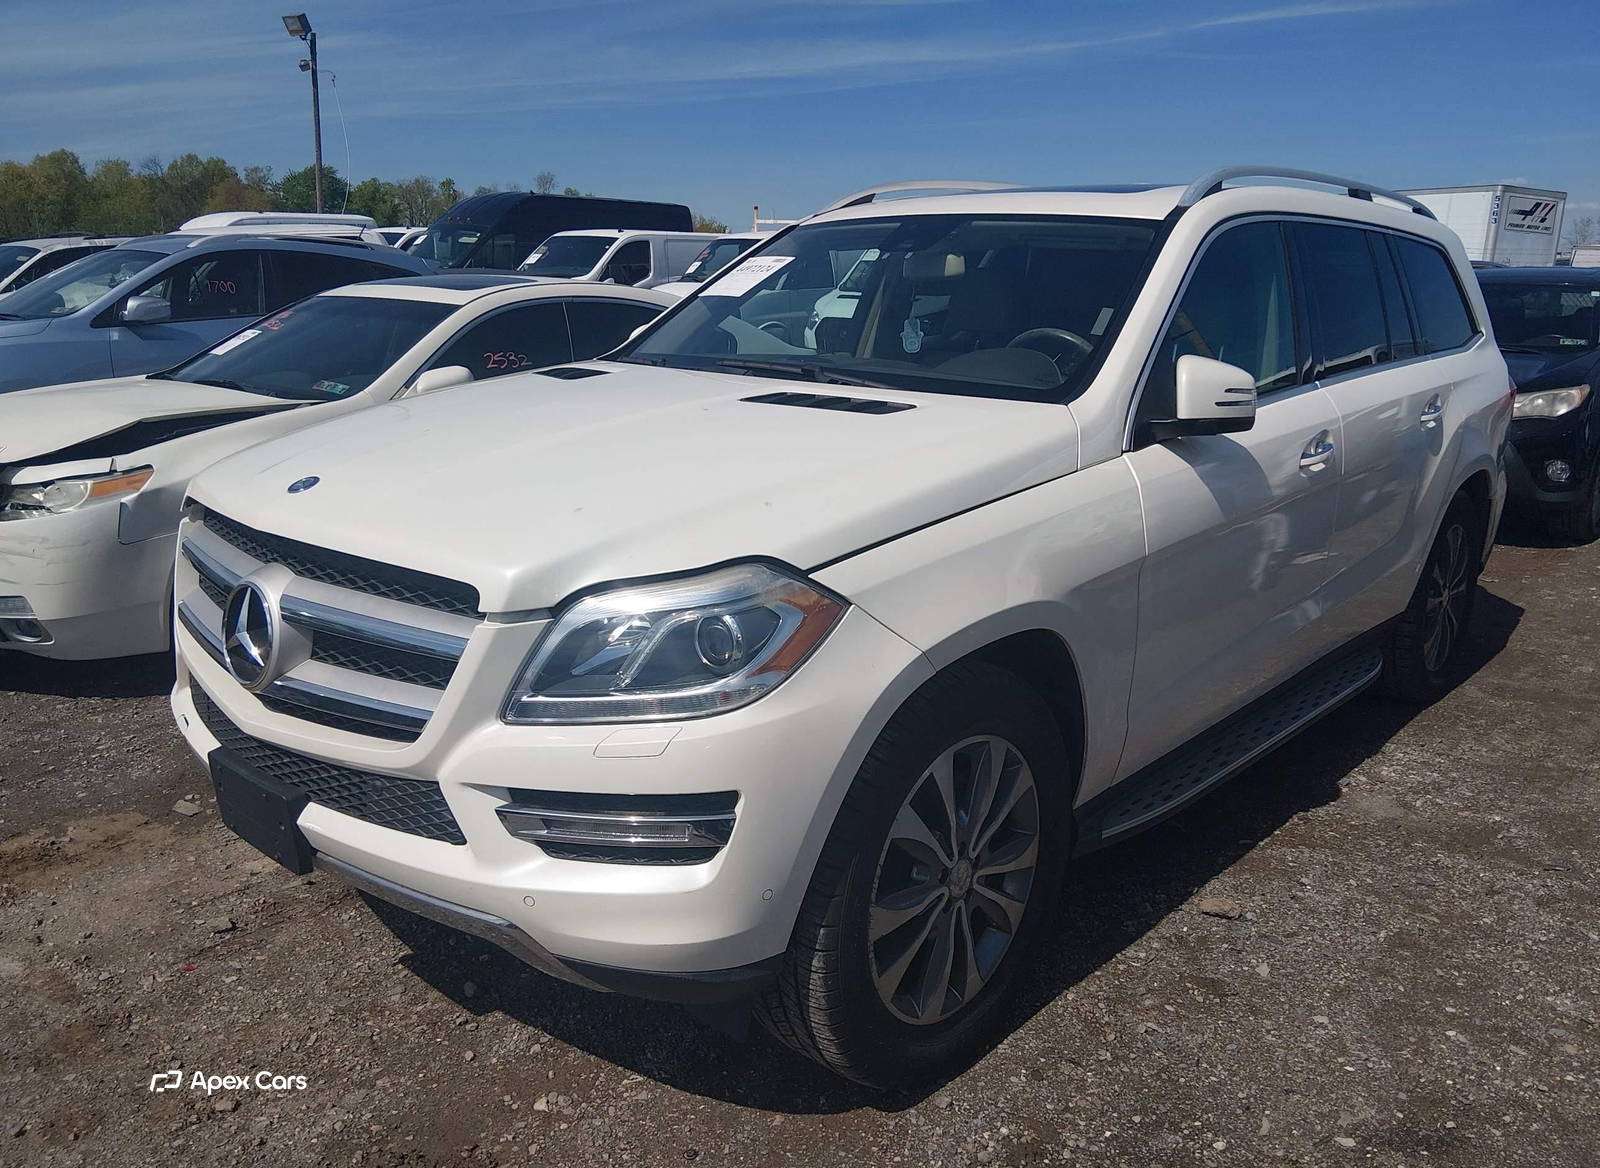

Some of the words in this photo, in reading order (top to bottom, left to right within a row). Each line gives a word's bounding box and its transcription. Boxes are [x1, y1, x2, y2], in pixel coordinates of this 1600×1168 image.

[1491, 195, 1501, 225] 5363
[207, 280, 236, 295] 1700
[483, 351, 533, 369] 2532
